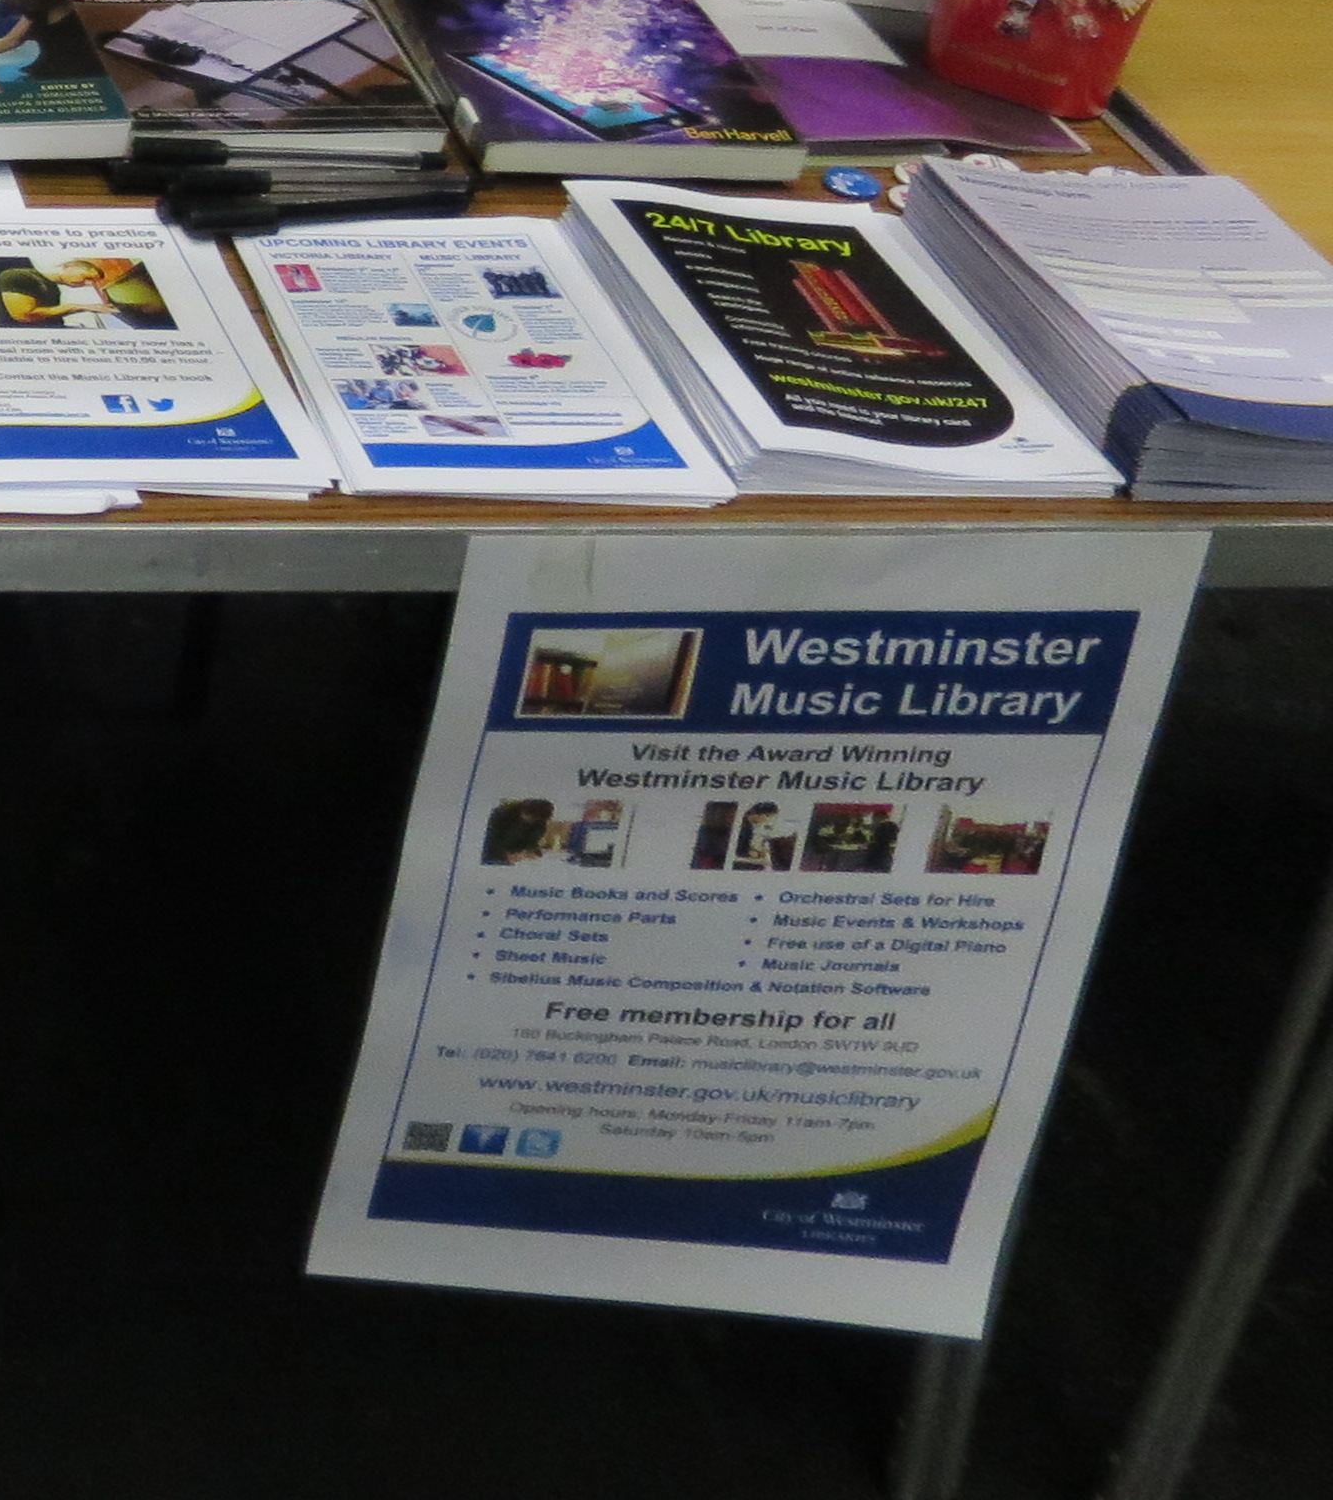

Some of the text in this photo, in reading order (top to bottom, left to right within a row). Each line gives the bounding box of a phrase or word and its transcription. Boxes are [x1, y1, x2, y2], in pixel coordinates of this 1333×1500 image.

[684, 127, 792, 141] Ben Harvell
[64, 228, 82, 236] to
[87, 229, 156, 238] practice
[259, 238, 527, 248] UPCOMING LIBRARY EVENTS
[644, 212, 854, 257] 24/7 Library
[769, 372, 989, 410] westminster.gov.uk/247
[746, 628, 1100, 665] Westminster
[730, 682, 1081, 724] Music Library
[632, 743, 951, 767] Visit the Award Winning
[577, 768, 984, 795] Westminster Music Library
[505, 907, 676, 924] Performance Parts
[499, 927, 608, 942] Choral Sets
[761, 957, 899, 972] Music Journals
[545, 1001, 895, 1032] Free membership for all
[478, 1076, 921, 1111] www.westminster.gov.uk/musiclibrary
